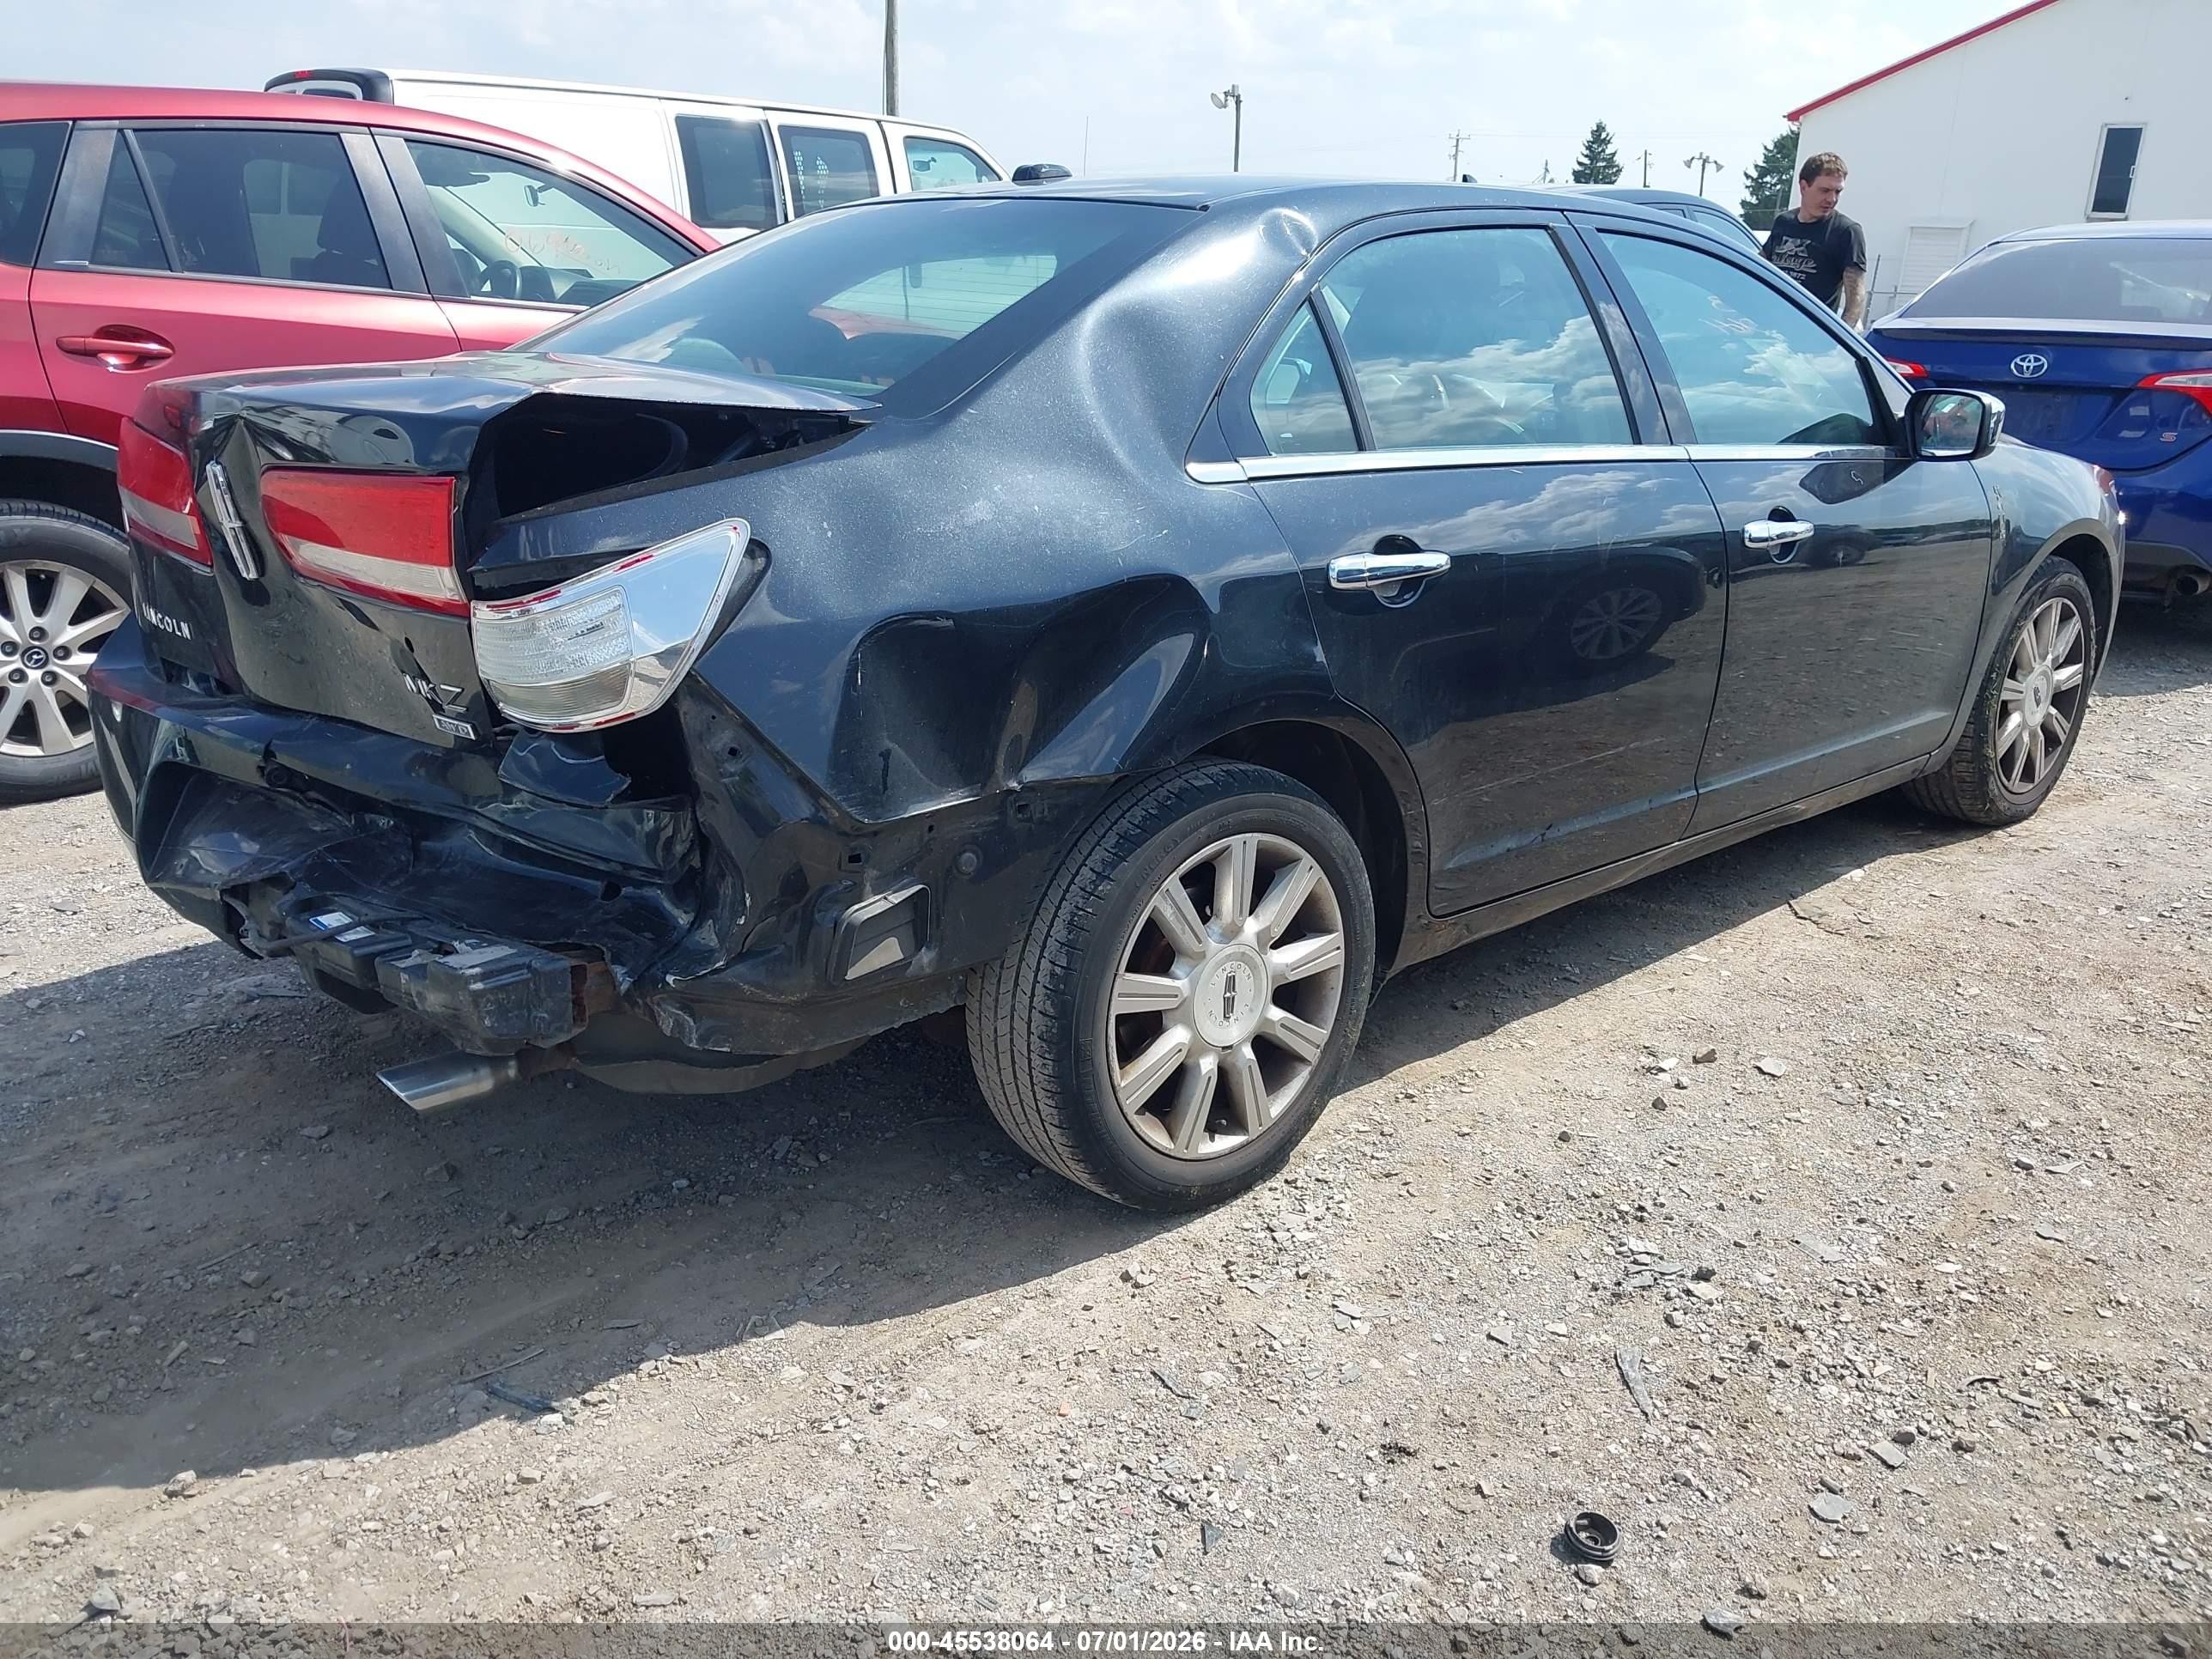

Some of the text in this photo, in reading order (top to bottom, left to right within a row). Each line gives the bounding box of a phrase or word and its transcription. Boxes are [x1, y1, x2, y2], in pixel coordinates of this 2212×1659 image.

[2159, 431, 2179, 442] S
[142, 602, 192, 641] LINCOLN
[403, 672, 468, 714] MKZ
[1209, 962, 1253, 988] LINCOLN
